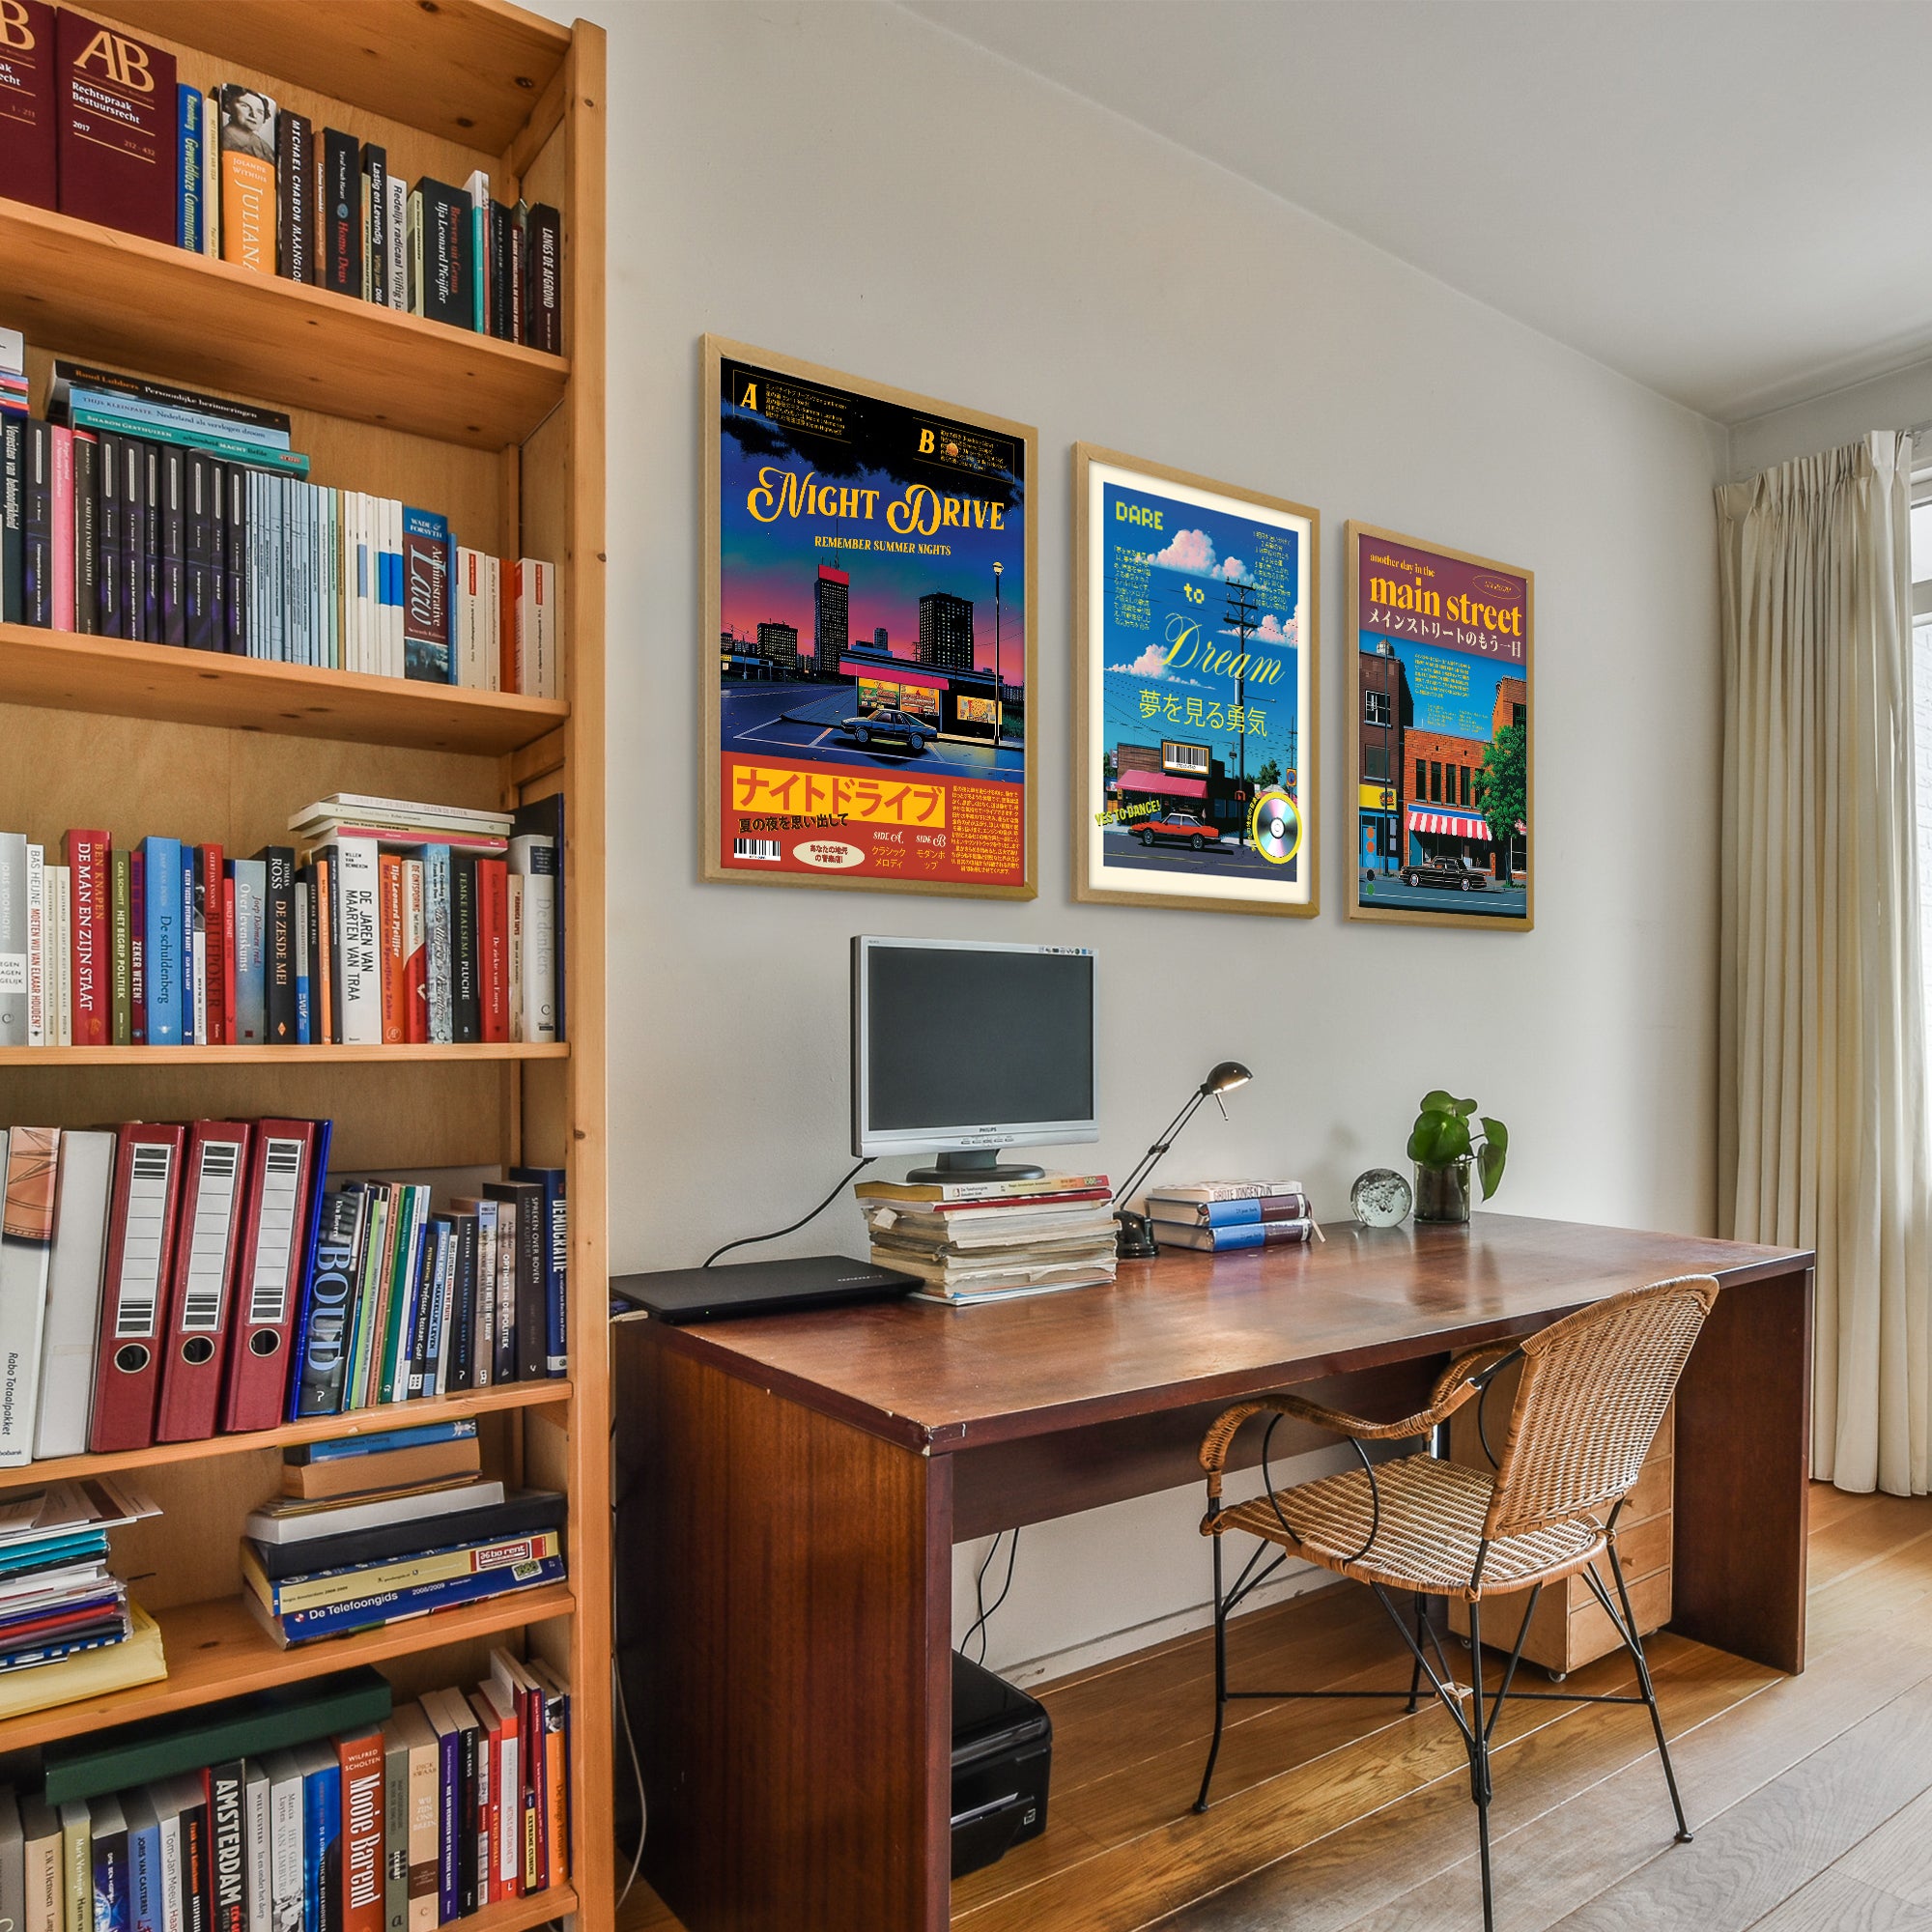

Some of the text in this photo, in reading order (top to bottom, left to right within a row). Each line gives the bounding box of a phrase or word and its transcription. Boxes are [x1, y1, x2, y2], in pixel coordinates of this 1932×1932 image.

[73, 30, 155, 92] AB
[72, 81, 132, 111] Rechtspraak
[72, 92, 140, 124] Bestuursrecht
[72, 121, 91, 133] 2017
[185, 138, 200, 190] Geweldloze
[233, 157, 267, 174] JOLANDE
[233, 167, 267, 184] WITHUIS
[292, 119, 301, 222] MICHAEL CHABON
[373, 162, 383, 245] Lastig en Levendig
[392, 185, 405, 298] Redelijk radicaal Vijftig
[436, 201, 448, 259] Ilja Leonard
[542, 227, 554, 254] LANGS
[338, 221, 349, 284] Homo Deus
[543, 255, 553, 268] DE
[543, 269, 554, 309] AFGROND
[144, 385, 197, 405] Persoonlijke
[198, 397, 258, 419] herinneringen
[156, 409, 194, 424] Nederland
[738, 383, 758, 412] A
[86, 414, 246, 453] SHARON GESTHUIZEN MACHT
[917, 428, 935, 454] B
[5, 425, 19, 530] Vereisten van behoorlijkheid
[410, 518, 431, 528] WADE
[1116, 500, 1164, 530] DARE
[814, 535, 952, 556] REMEMBER SUMMER NIGHTS
[410, 543, 446, 628] Law
[1370, 554, 1435, 578] another day in the
[1183, 582, 1205, 605] to
[1370, 577, 1522, 637] main street
[1160, 611, 1287, 685] Dream
[1368, 608, 1521, 659] メインストリートのもう一日
[1138, 688, 1268, 737] 夢を見る勇気
[736, 767, 943, 823] ナイトドライブ
[1094, 800, 1161, 827] YES TO DANCE!
[738, 812, 849, 835] 夏の夜を思い出して
[872, 831, 890, 840] SIDE
[916, 835, 932, 844] SIDE
[871, 846, 906, 857] クラシック
[875, 858, 903, 869] メロディ
[95, 843, 104, 920] BEN KNAPEN
[78, 842, 93, 1011] DE MAN EN ZIJN STAAT
[117, 910, 126, 925] HET
[239, 883, 252, 973] Over levenskunst
[251, 895, 262, 948] Joep Dohmen
[271, 858, 287, 985] ROSS DE ZESDE MEI
[359, 891, 374, 973] DE JAREN VAN
[459, 872, 469, 1000] FEMKE HALSEMA PLUCHE
[537, 898, 553, 976] De denkers
[30, 850, 42, 1028] BAS HEIJNE MOETEN WIJ VAN ELKAAR HOUDEN?
[117, 927, 126, 957] BEGRIP
[132, 940, 142, 968] ZEKER
[346, 890, 360, 1002] MAARTEN VAN TRAA
[117, 959, 126, 999] POLITIEK
[157, 916, 173, 1004] De schuldenberg
[531, 1197, 540, 1231] SPREKEN
[532, 1256, 541, 1284] BOVEN
[307, 1243, 353, 1372] BOUD
[501, 1254, 510, 1349] OPTIMIST IN DE POLITIEK
[415, 1283, 431, 1360] Professor, bestaat God?
[429, 1325, 438, 1350] LEVEN
[1, 1352, 18, 1436] Rabo Totaalpakket
[503, 1545, 526, 1556] rent
[309, 1592, 399, 1620] De Telefoongids
[345, 1757, 381, 1772] SCHOLTEN
[348, 1749, 379, 1762] WILFRED
[415, 1762, 434, 1772] DICK
[278, 1796, 288, 1823] Luyten
[216, 1779, 242, 1906] AMSTERDAM
[350, 1772, 382, 1910] Mooie Barend
[138, 1836, 149, 1916] JORIS VAN CASTEREN
[165, 1832, 179, 1909] Tom-Jan Meeus
